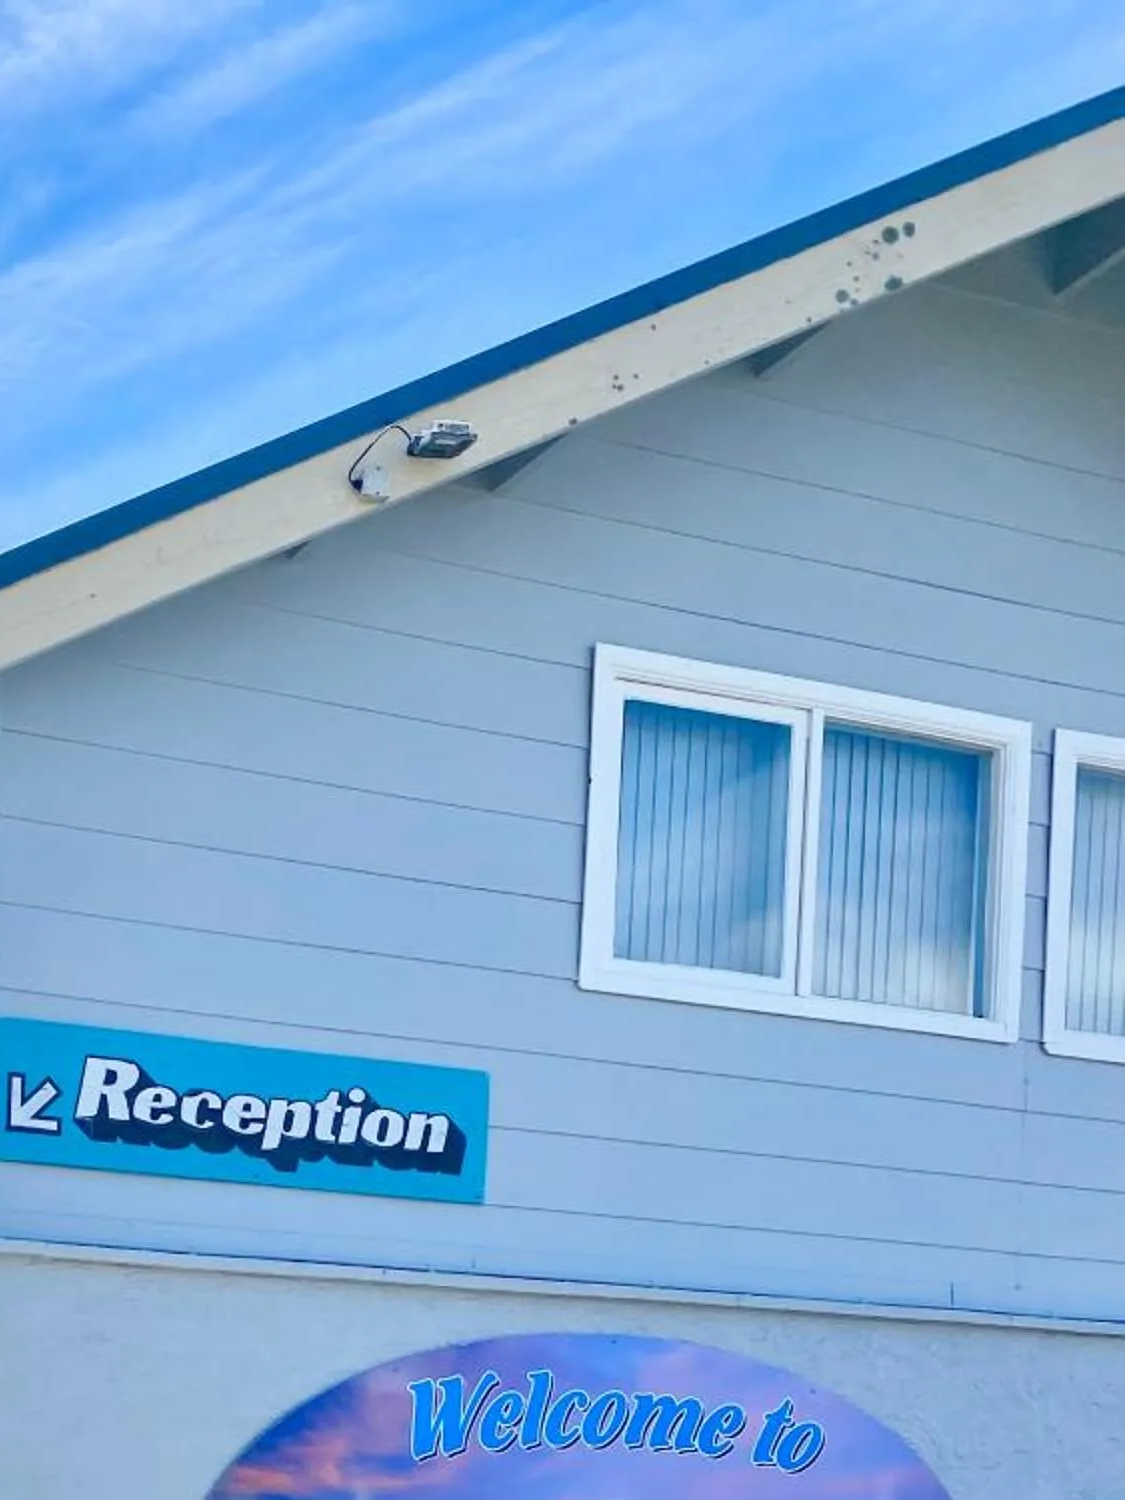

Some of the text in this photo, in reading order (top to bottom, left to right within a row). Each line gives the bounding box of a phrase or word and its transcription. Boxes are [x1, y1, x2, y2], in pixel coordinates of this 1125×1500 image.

[75, 1055, 455, 1162] Reception
[407, 1369, 826, 1474] Welcome to
